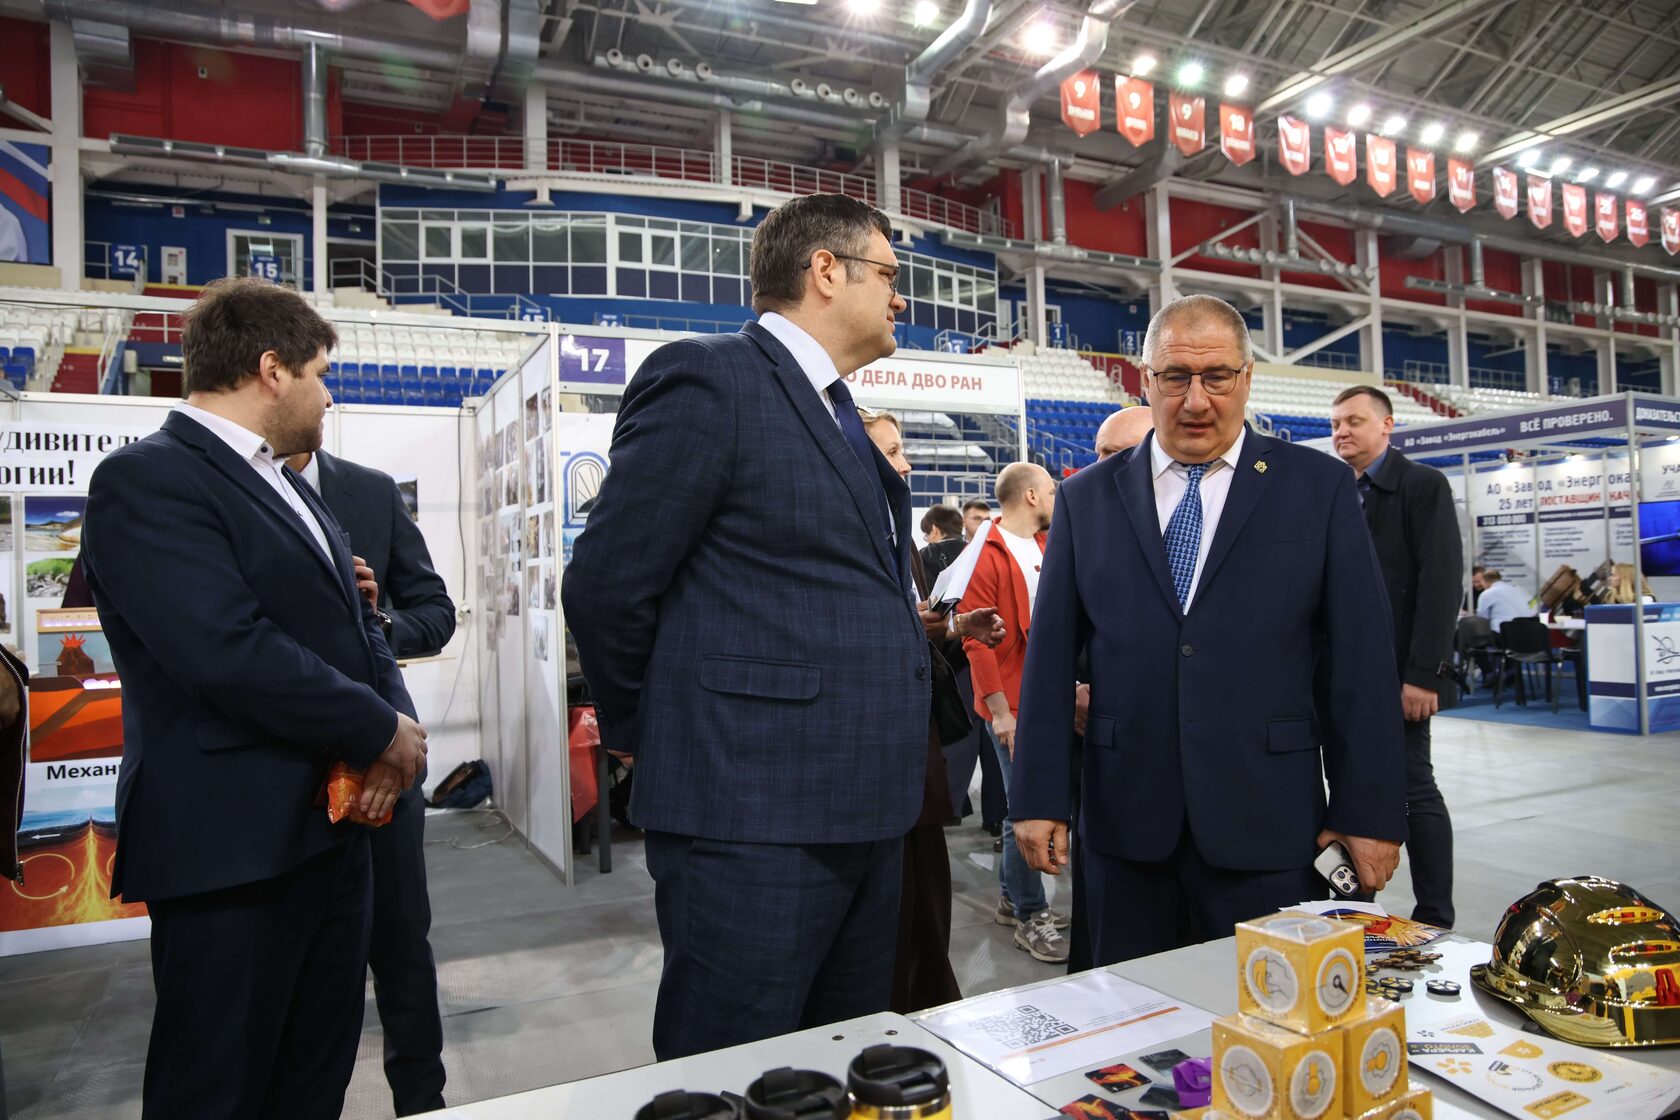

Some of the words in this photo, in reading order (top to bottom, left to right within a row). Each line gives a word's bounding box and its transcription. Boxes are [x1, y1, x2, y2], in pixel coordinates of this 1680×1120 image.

[1074, 81, 1086, 98] 9
[1129, 92, 1141, 109] 9
[1181, 104, 1192, 120] 9
[114, 250, 139, 268] 14
[254, 262, 278, 278] 15
[578, 348, 610, 372] 17
[861, 369, 908, 387] ДЕЛА
[911, 372, 947, 390] ДВО
[950, 375, 982, 391] РАН
[1519, 418, 1541, 433] ВСЁ
[1542, 409, 1614, 430] ПРОВЕРЕНО.
[0, 430, 139, 453] дивител
[1499, 499, 1512, 511] 25
[47, 764, 121, 780] Механ
